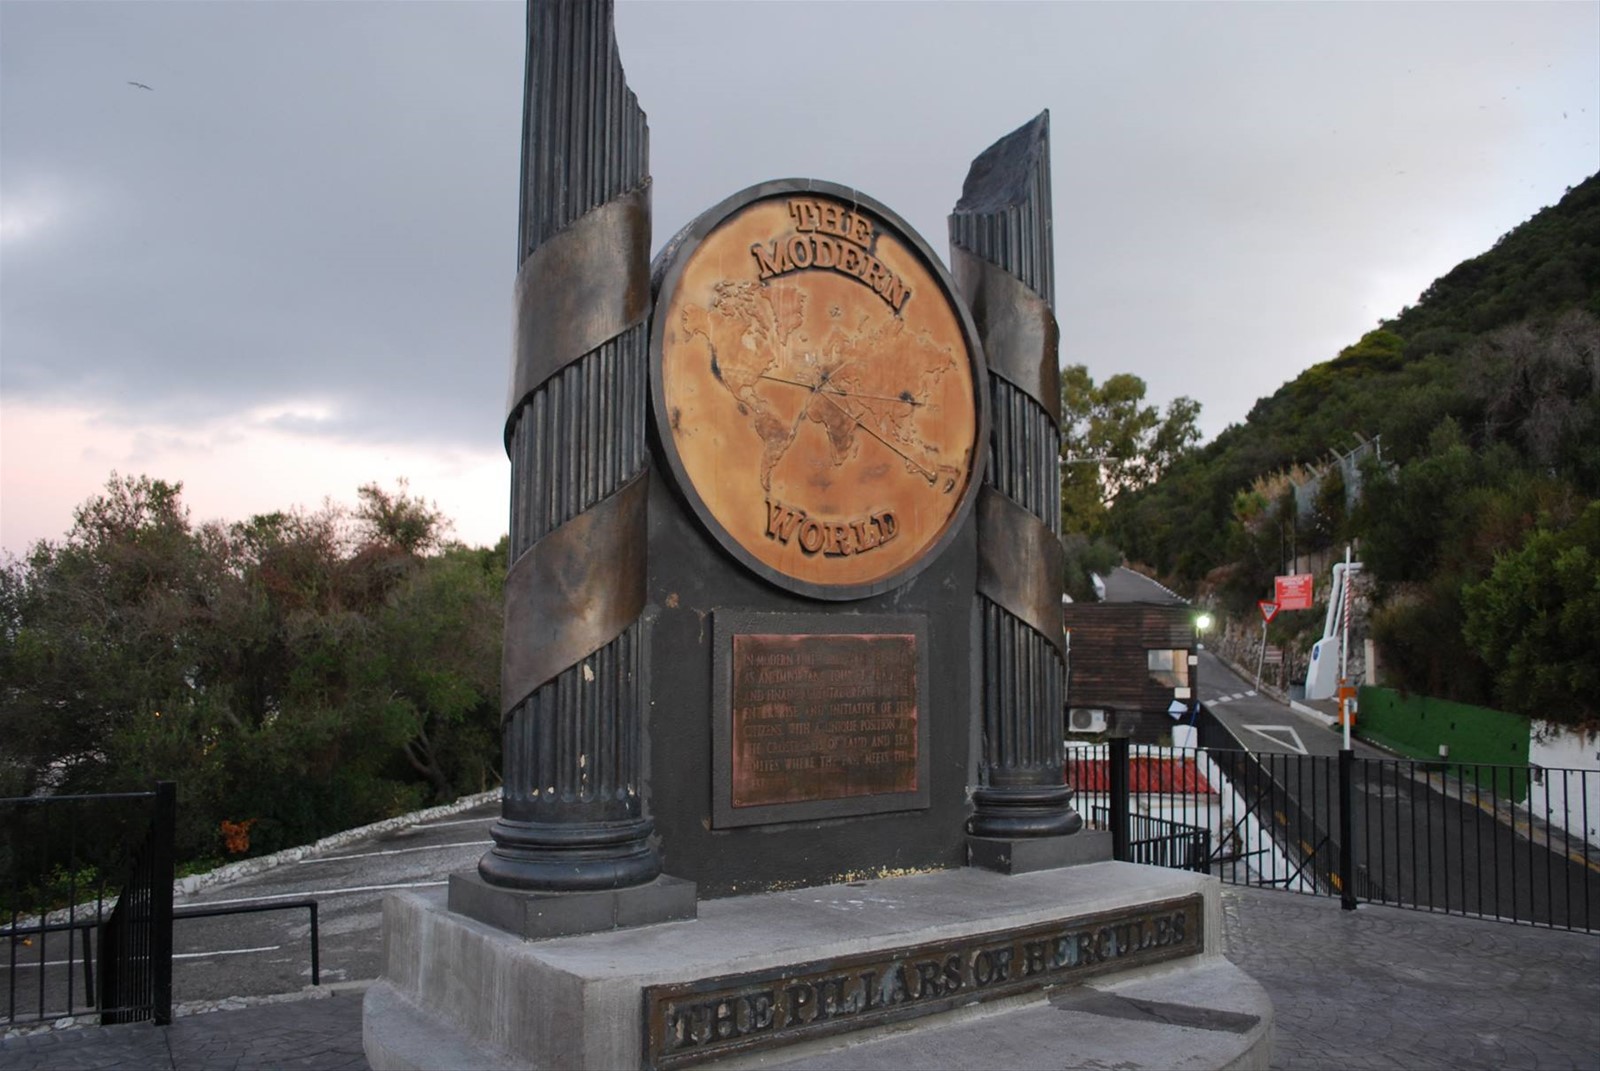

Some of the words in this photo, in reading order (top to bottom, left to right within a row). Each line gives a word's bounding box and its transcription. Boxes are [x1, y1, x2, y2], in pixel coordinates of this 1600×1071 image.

[788, 200, 873, 247] THE
[751, 234, 911, 315] MODERN
[765, 500, 900, 557] WORLD
[829, 702, 876, 716] INITIATIVE
[880, 700, 891, 714] OF
[860, 718, 896, 732] POSITION
[871, 733, 890, 748] AND
[665, 989, 775, 1049] THE
[783, 953, 963, 1025] PILLARS
[972, 946, 1015, 988] OF
[1022, 911, 1187, 977] HERCULES
